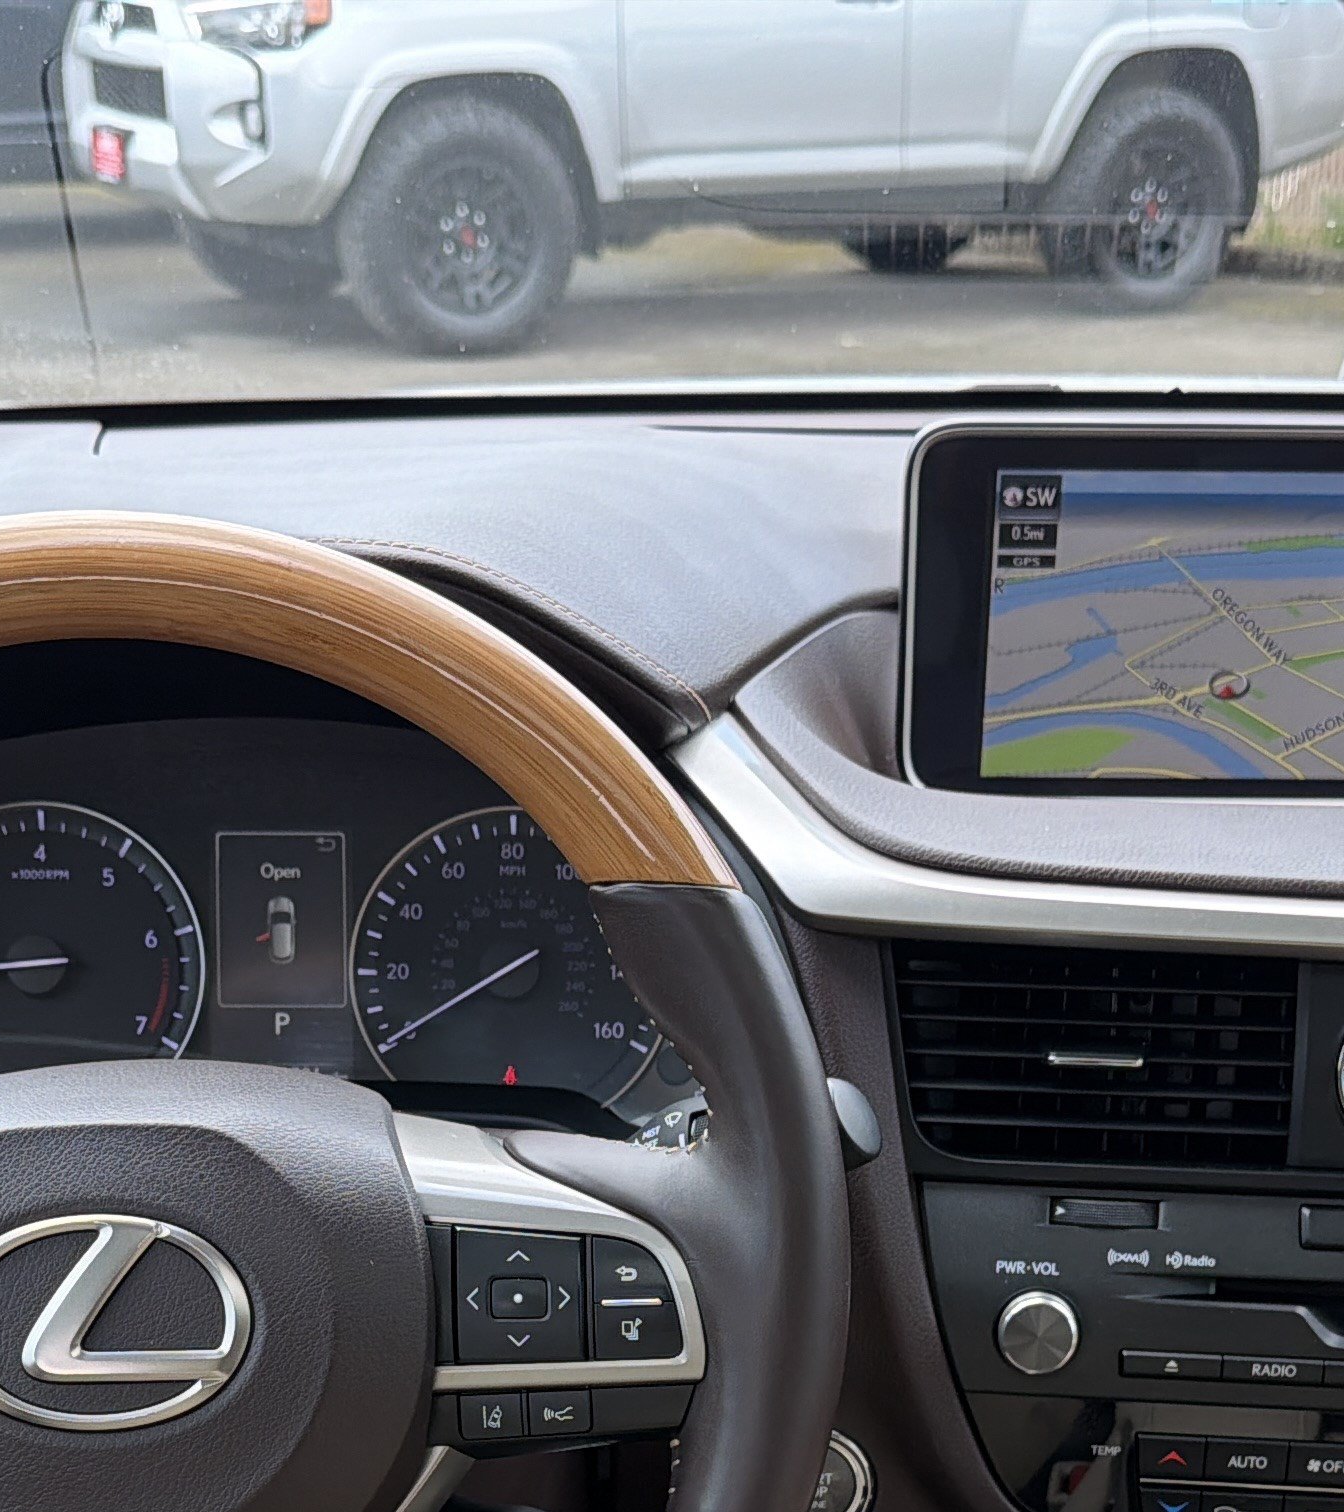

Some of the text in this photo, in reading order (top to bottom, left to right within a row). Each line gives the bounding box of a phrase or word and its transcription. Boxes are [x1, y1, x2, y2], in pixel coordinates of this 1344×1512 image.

[1025, 486, 1056, 507] SW
[1010, 525, 1045, 541] 0.5mi
[1011, 556, 1041, 567] GPS
[1211, 586, 1292, 666] OREGON WAY
[1150, 677, 1204, 720] 3RD AVE
[33, 844, 47, 862] 4
[501, 842, 525, 860] 80
[102, 867, 116, 887] 5
[260, 862, 302, 881] Open
[441, 862, 466, 880] 60
[499, 866, 526, 878] MPH
[399, 903, 424, 921] 40
[144, 930, 158, 949] 6
[386, 962, 410, 981] 20
[134, 1013, 150, 1036] 7
[274, 1011, 291, 1036] P
[593, 1020, 626, 1039] 160
[1184, 1254, 1216, 1268] Radio
[1251, 1363, 1297, 1378] RADIO
[1091, 1444, 1122, 1457] TEMP
[1227, 1455, 1268, 1470] AUTO
